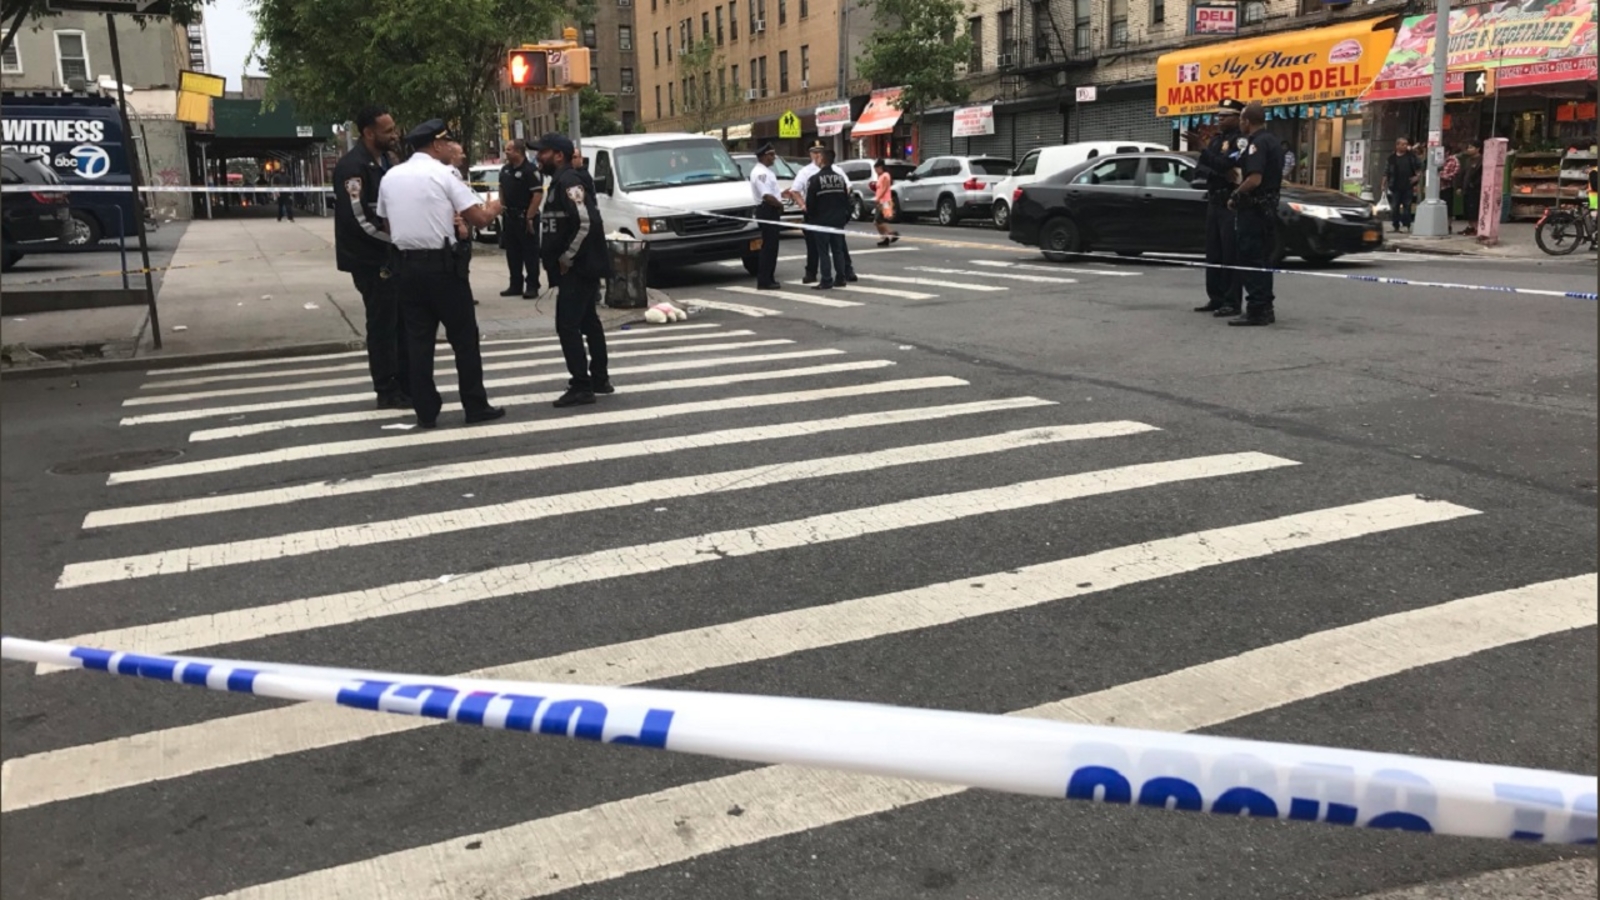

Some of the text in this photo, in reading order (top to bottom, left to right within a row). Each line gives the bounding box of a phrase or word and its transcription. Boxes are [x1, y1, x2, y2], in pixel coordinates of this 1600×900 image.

[1199, 10, 1234, 22] DELI
[1491, 20, 1575, 46] VEGETABLES
[1208, 56, 1249, 79] My
[1250, 51, 1317, 71] Place
[1167, 79, 1243, 106] MARKET
[1248, 72, 1304, 98] FOOD
[1309, 64, 1360, 90] DELI
[2, 119, 104, 142] WITNESS
[54, 157, 79, 167] abc
[69, 144, 110, 179] 7
